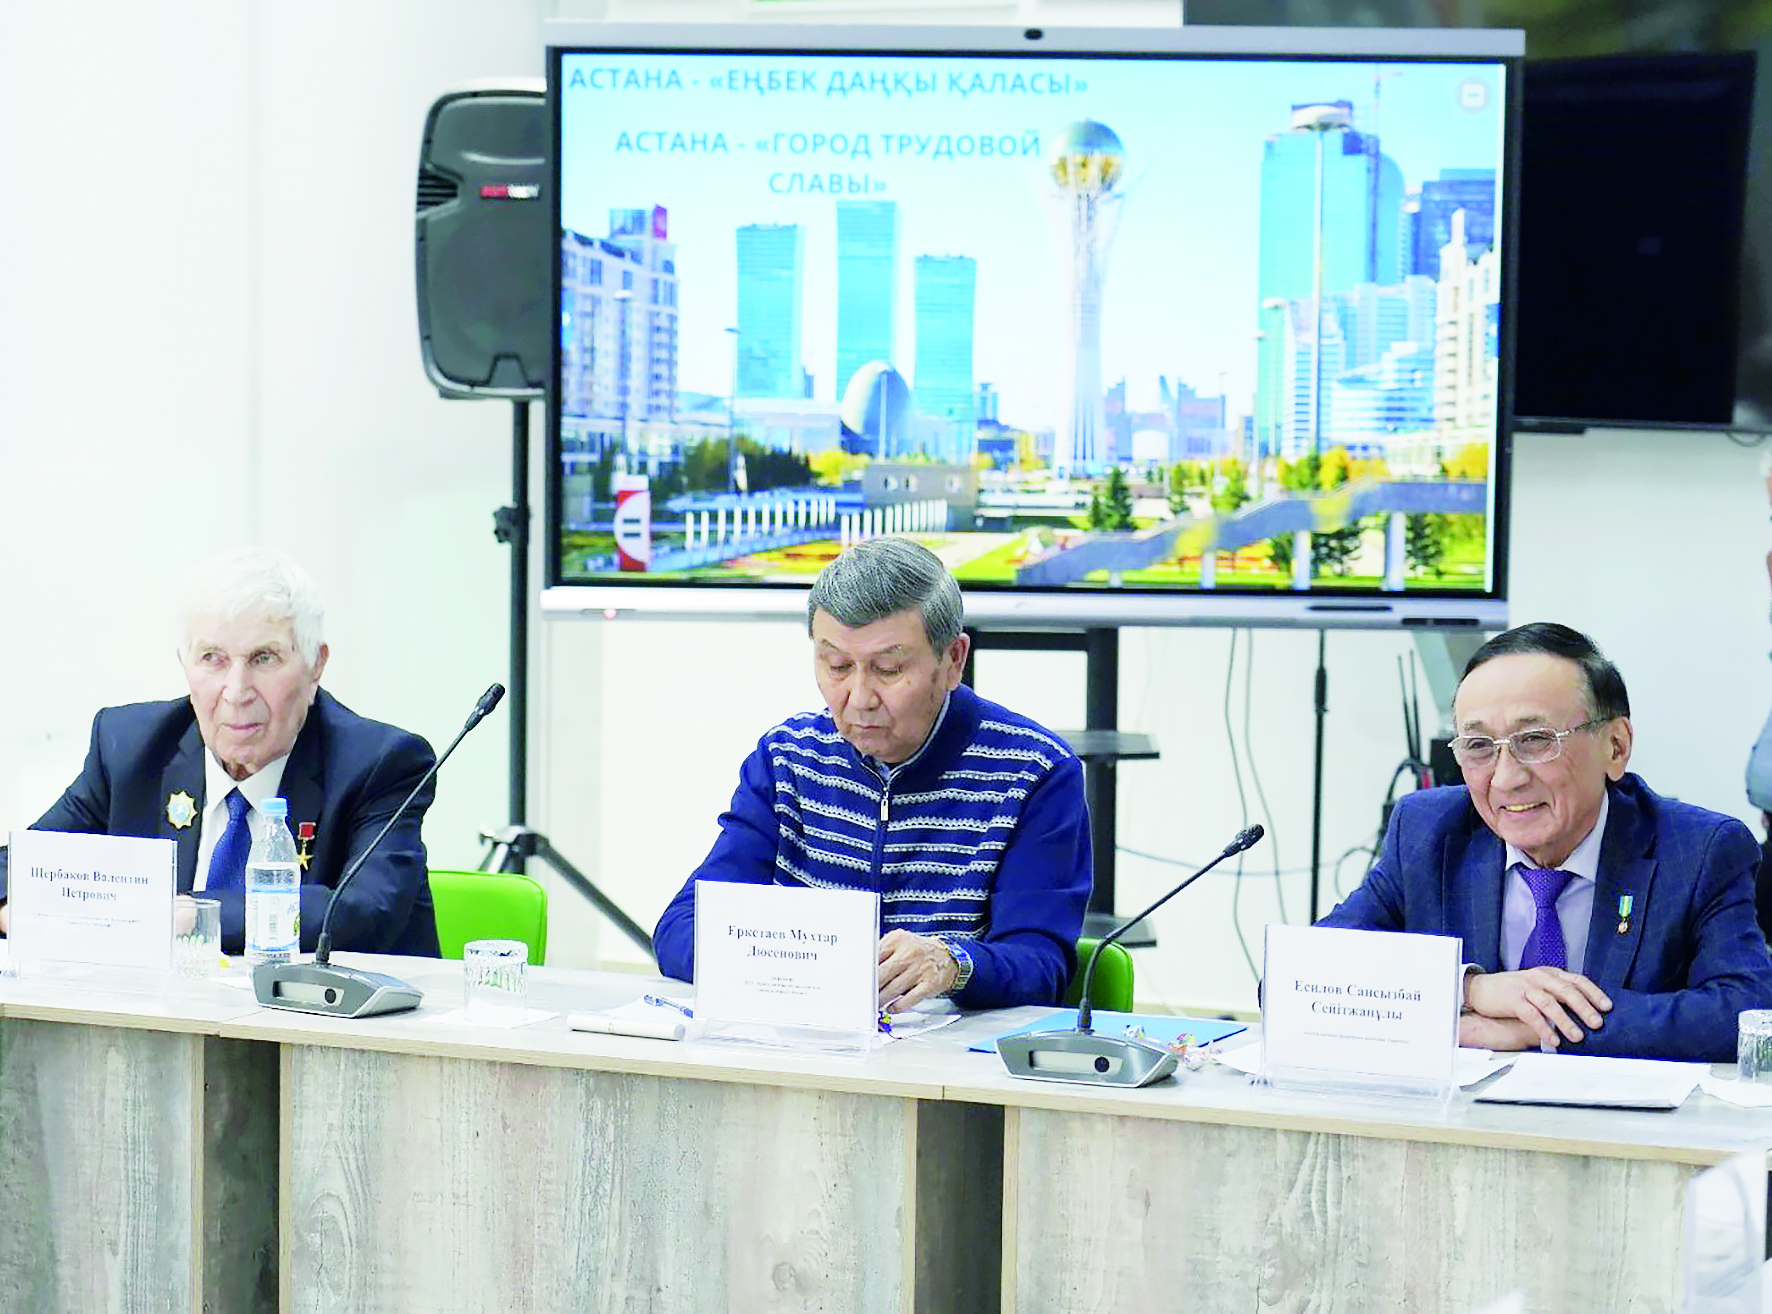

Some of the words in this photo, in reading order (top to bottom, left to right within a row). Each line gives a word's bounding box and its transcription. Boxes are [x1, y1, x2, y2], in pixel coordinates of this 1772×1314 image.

[569, 68, 683, 90] АСТАНА
[710, 69, 818, 97] «ЕҢБЕК
[826, 70, 937, 99] ДАҢҚЫ
[948, 71, 1089, 100] ҚАЛАСЫ»
[615, 131, 730, 153] АСТАНА
[755, 132, 871, 161] «ГОРОД
[881, 128, 1040, 162] ТРУДОВОЙ
[769, 172, 887, 194] СЛАВЫ»
[93, 870, 149, 885] Валентин
[61, 886, 117, 902] Петрович
[790, 928, 839, 946] Мухтар
[746, 944, 818, 961] Дюсенович
[1294, 979, 1342, 995] Есилов
[1346, 983, 1422, 1002] Сансызбай
